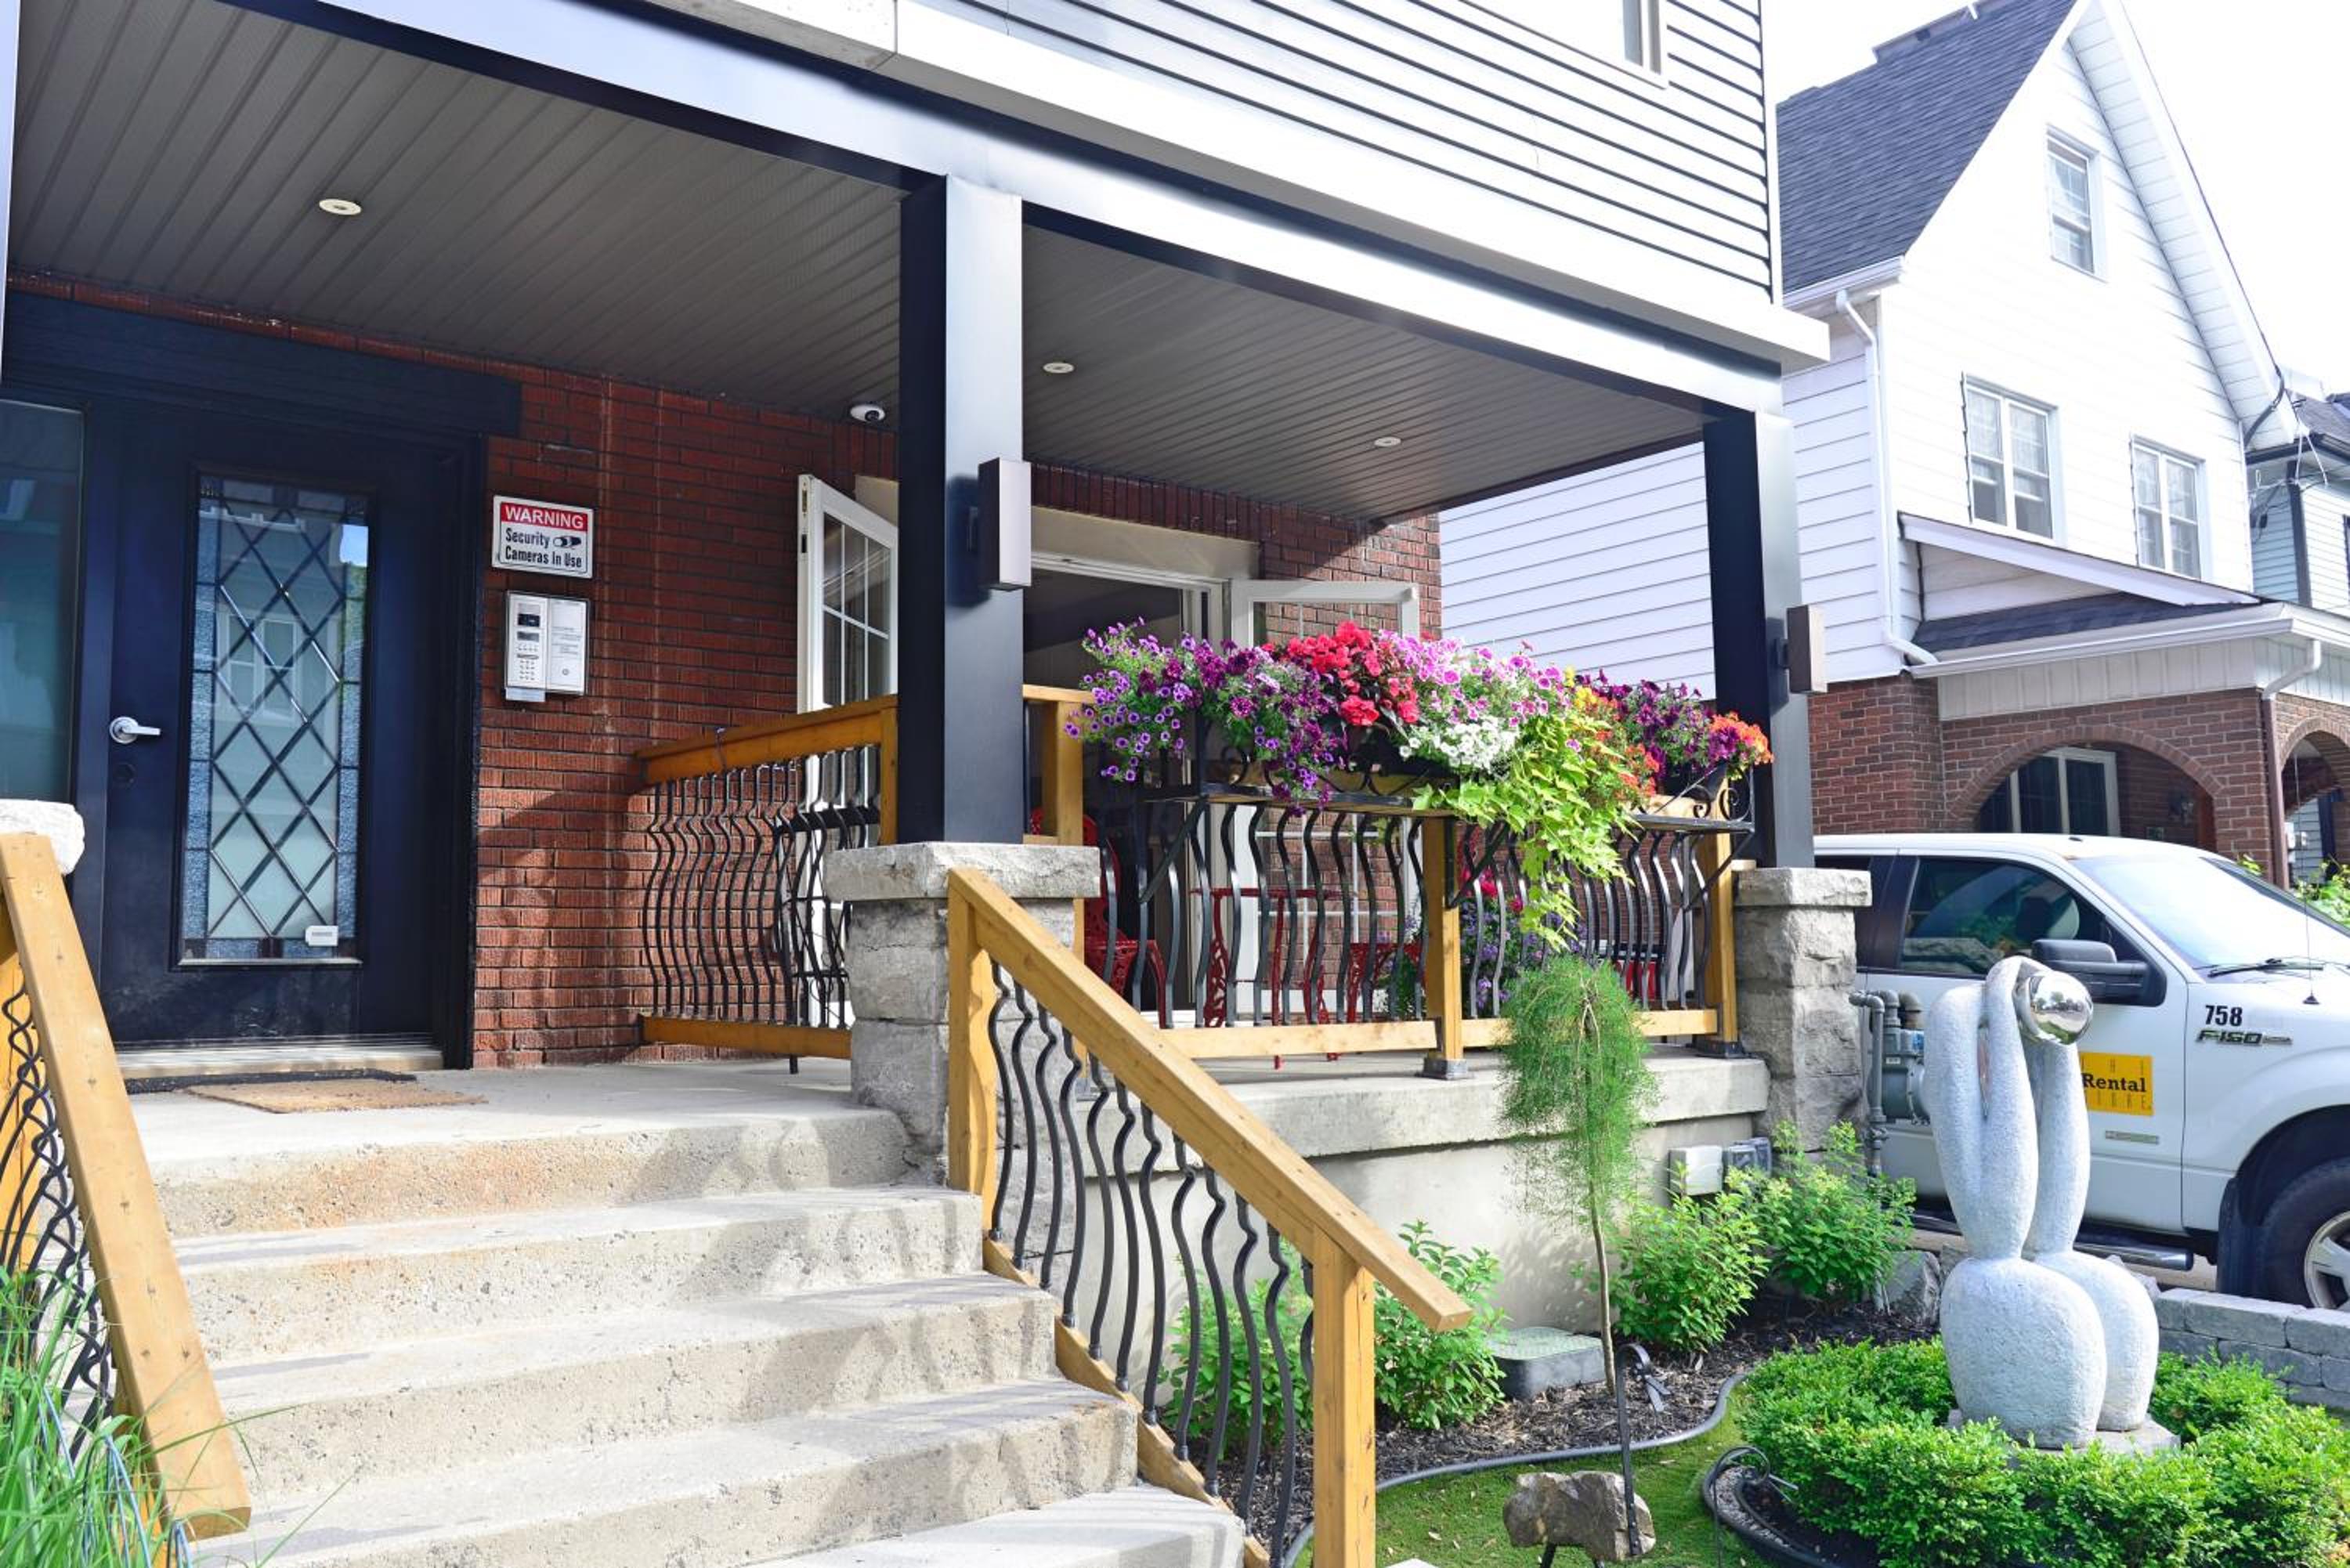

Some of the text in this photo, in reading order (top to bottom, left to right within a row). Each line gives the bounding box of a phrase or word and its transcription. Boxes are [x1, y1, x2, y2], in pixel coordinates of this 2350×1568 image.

[504, 505, 584, 529] WARNING
[505, 528, 550, 549] Security
[505, 545, 582, 568] Cameras In Use
[2205, 1005, 2243, 1027] 758
[2081, 1072, 2147, 1093] Rental
